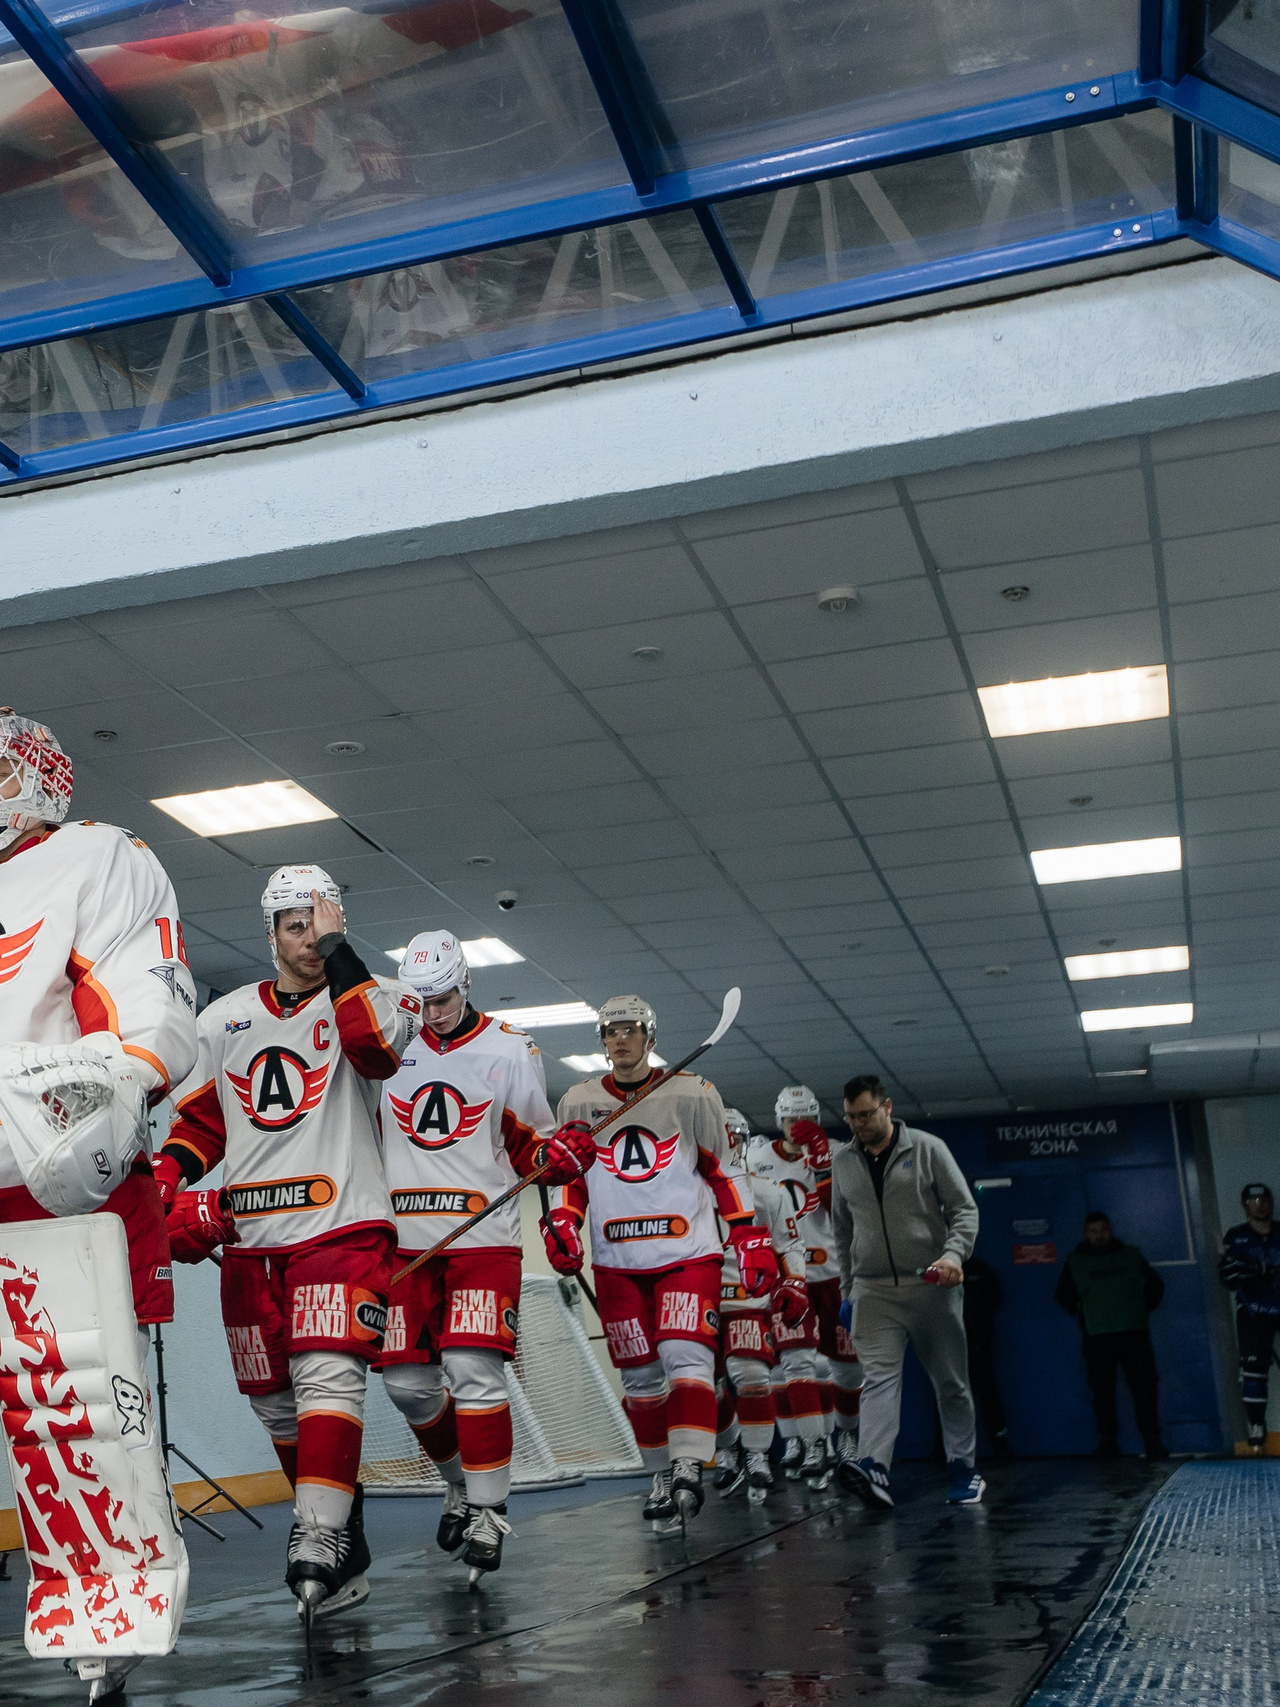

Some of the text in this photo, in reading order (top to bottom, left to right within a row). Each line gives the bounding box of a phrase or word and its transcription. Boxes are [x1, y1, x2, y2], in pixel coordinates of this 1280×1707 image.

[296, 891, 327, 899] соз
[414, 951, 428, 964] 79
[414, 985, 433, 993] огаз
[238, 1021, 250, 1029] сбп
[997, 1119, 1118, 1141] ТЕХНИЧЕСКАЯ
[1030, 1139, 1079, 1156] ЗОНА
[232, 1185, 306, 1212] WINLINE
[395, 1194, 465, 1212] WINLINE
[608, 1219, 669, 1239] WINLINE
[293, 1283, 346, 1312] SIMA
[451, 1289, 497, 1314] SIMA
[662, 1291, 699, 1312] SIMA
[292, 1310, 346, 1339] LAND
[450, 1311, 497, 1336] LAND
[606, 1317, 644, 1341] SIMA
[660, 1310, 699, 1332] LAND
[729, 1319, 761, 1334] SIMA
[382, 1328, 406, 1353] ND
[611, 1335, 650, 1359] LAND
[730, 1332, 762, 1350] LAND
